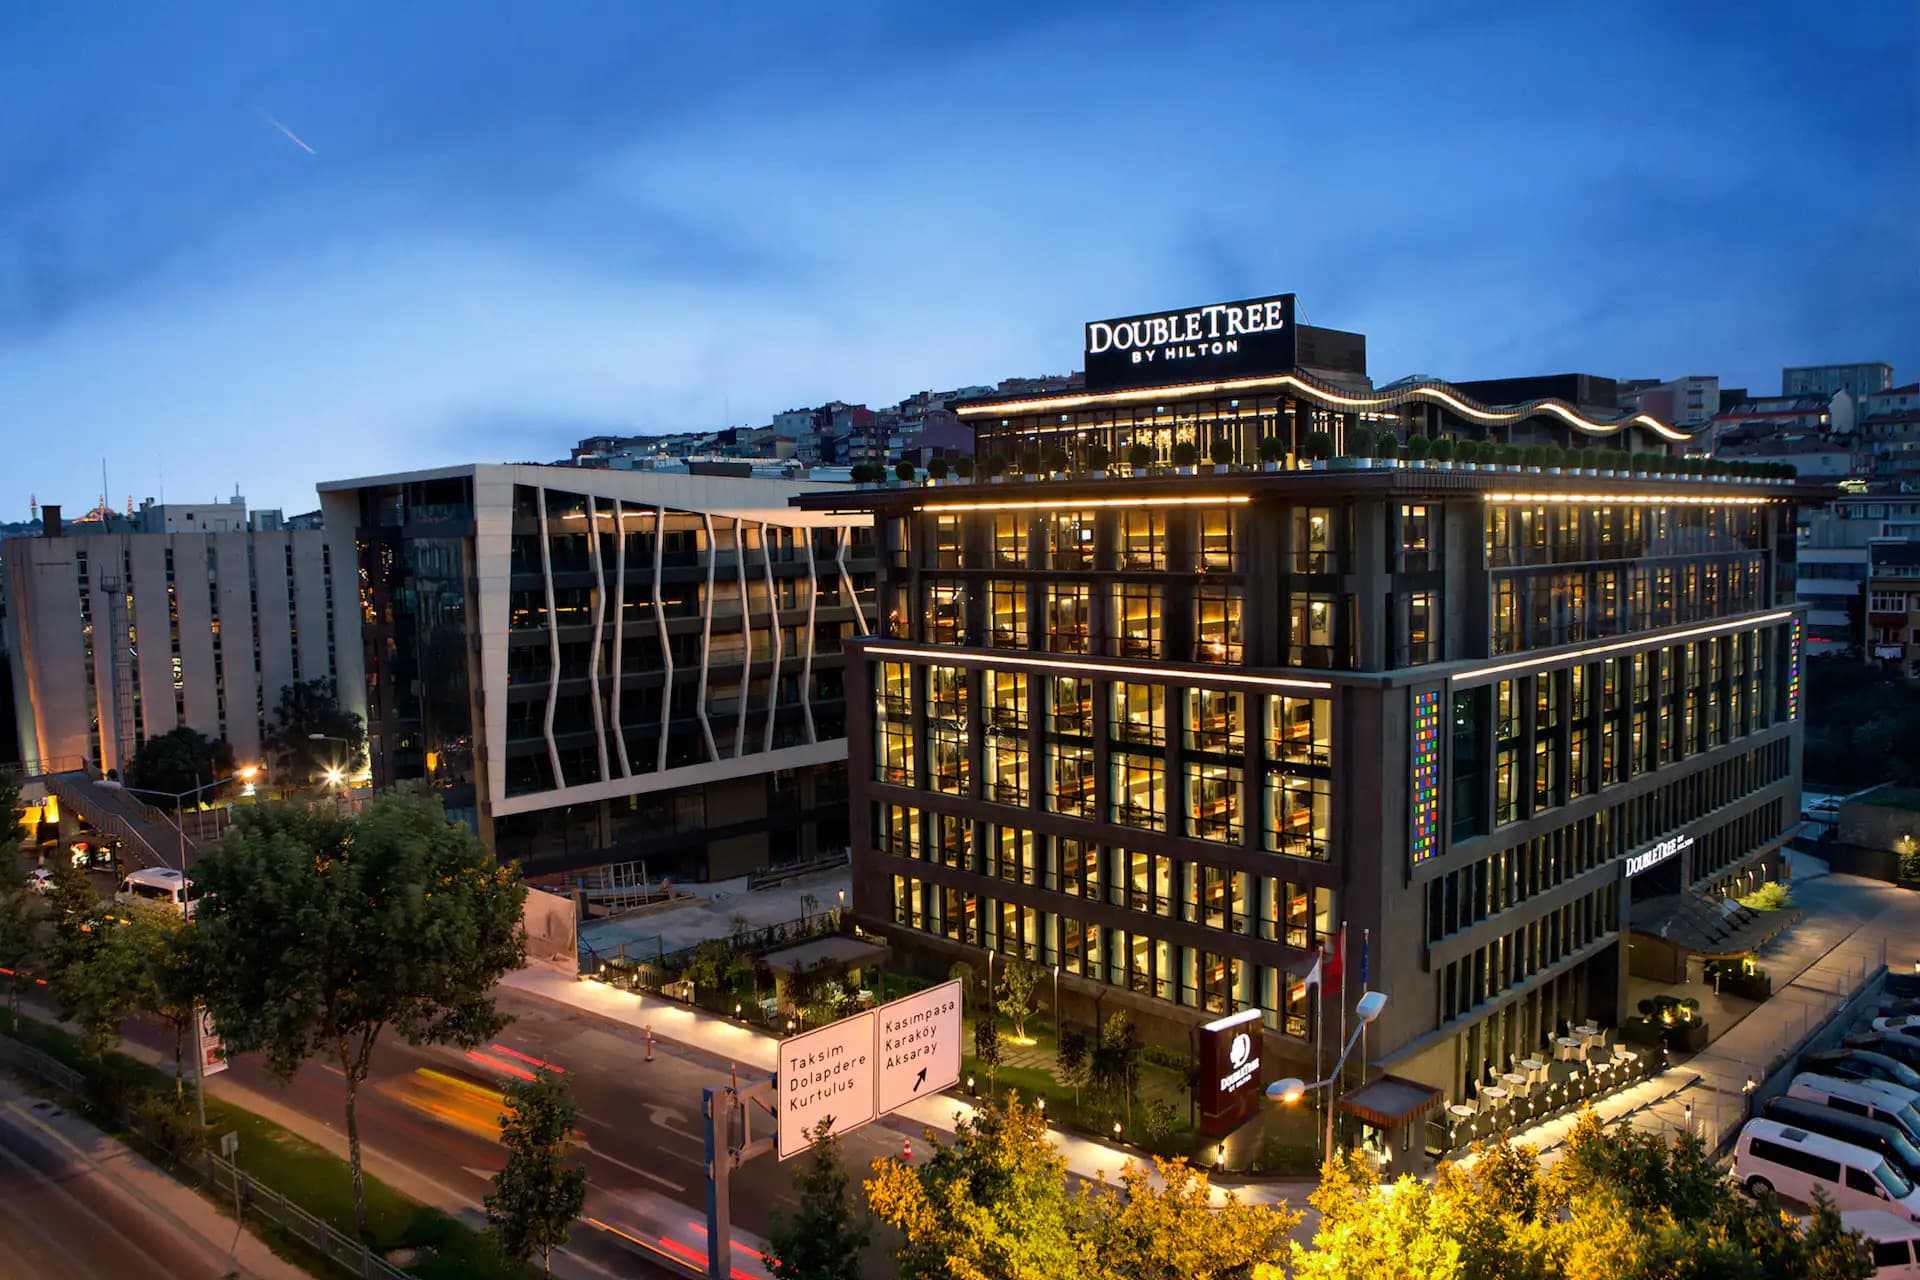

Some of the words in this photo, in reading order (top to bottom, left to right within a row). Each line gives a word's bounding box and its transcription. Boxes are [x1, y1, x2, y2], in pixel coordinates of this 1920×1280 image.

[1089, 301, 1283, 353] DOUBLETREE
[1131, 350, 1156, 363] BY
[1165, 340, 1238, 360] HILTON
[885, 1001, 955, 1034] Kasımpaşa
[885, 1024, 937, 1052] Karaköy
[790, 1045, 844, 1072] Taksim
[886, 1042, 938, 1071] Aksaray
[790, 1055, 866, 1092] Dolapdere
[790, 1078, 854, 1111] Kurtuluş
